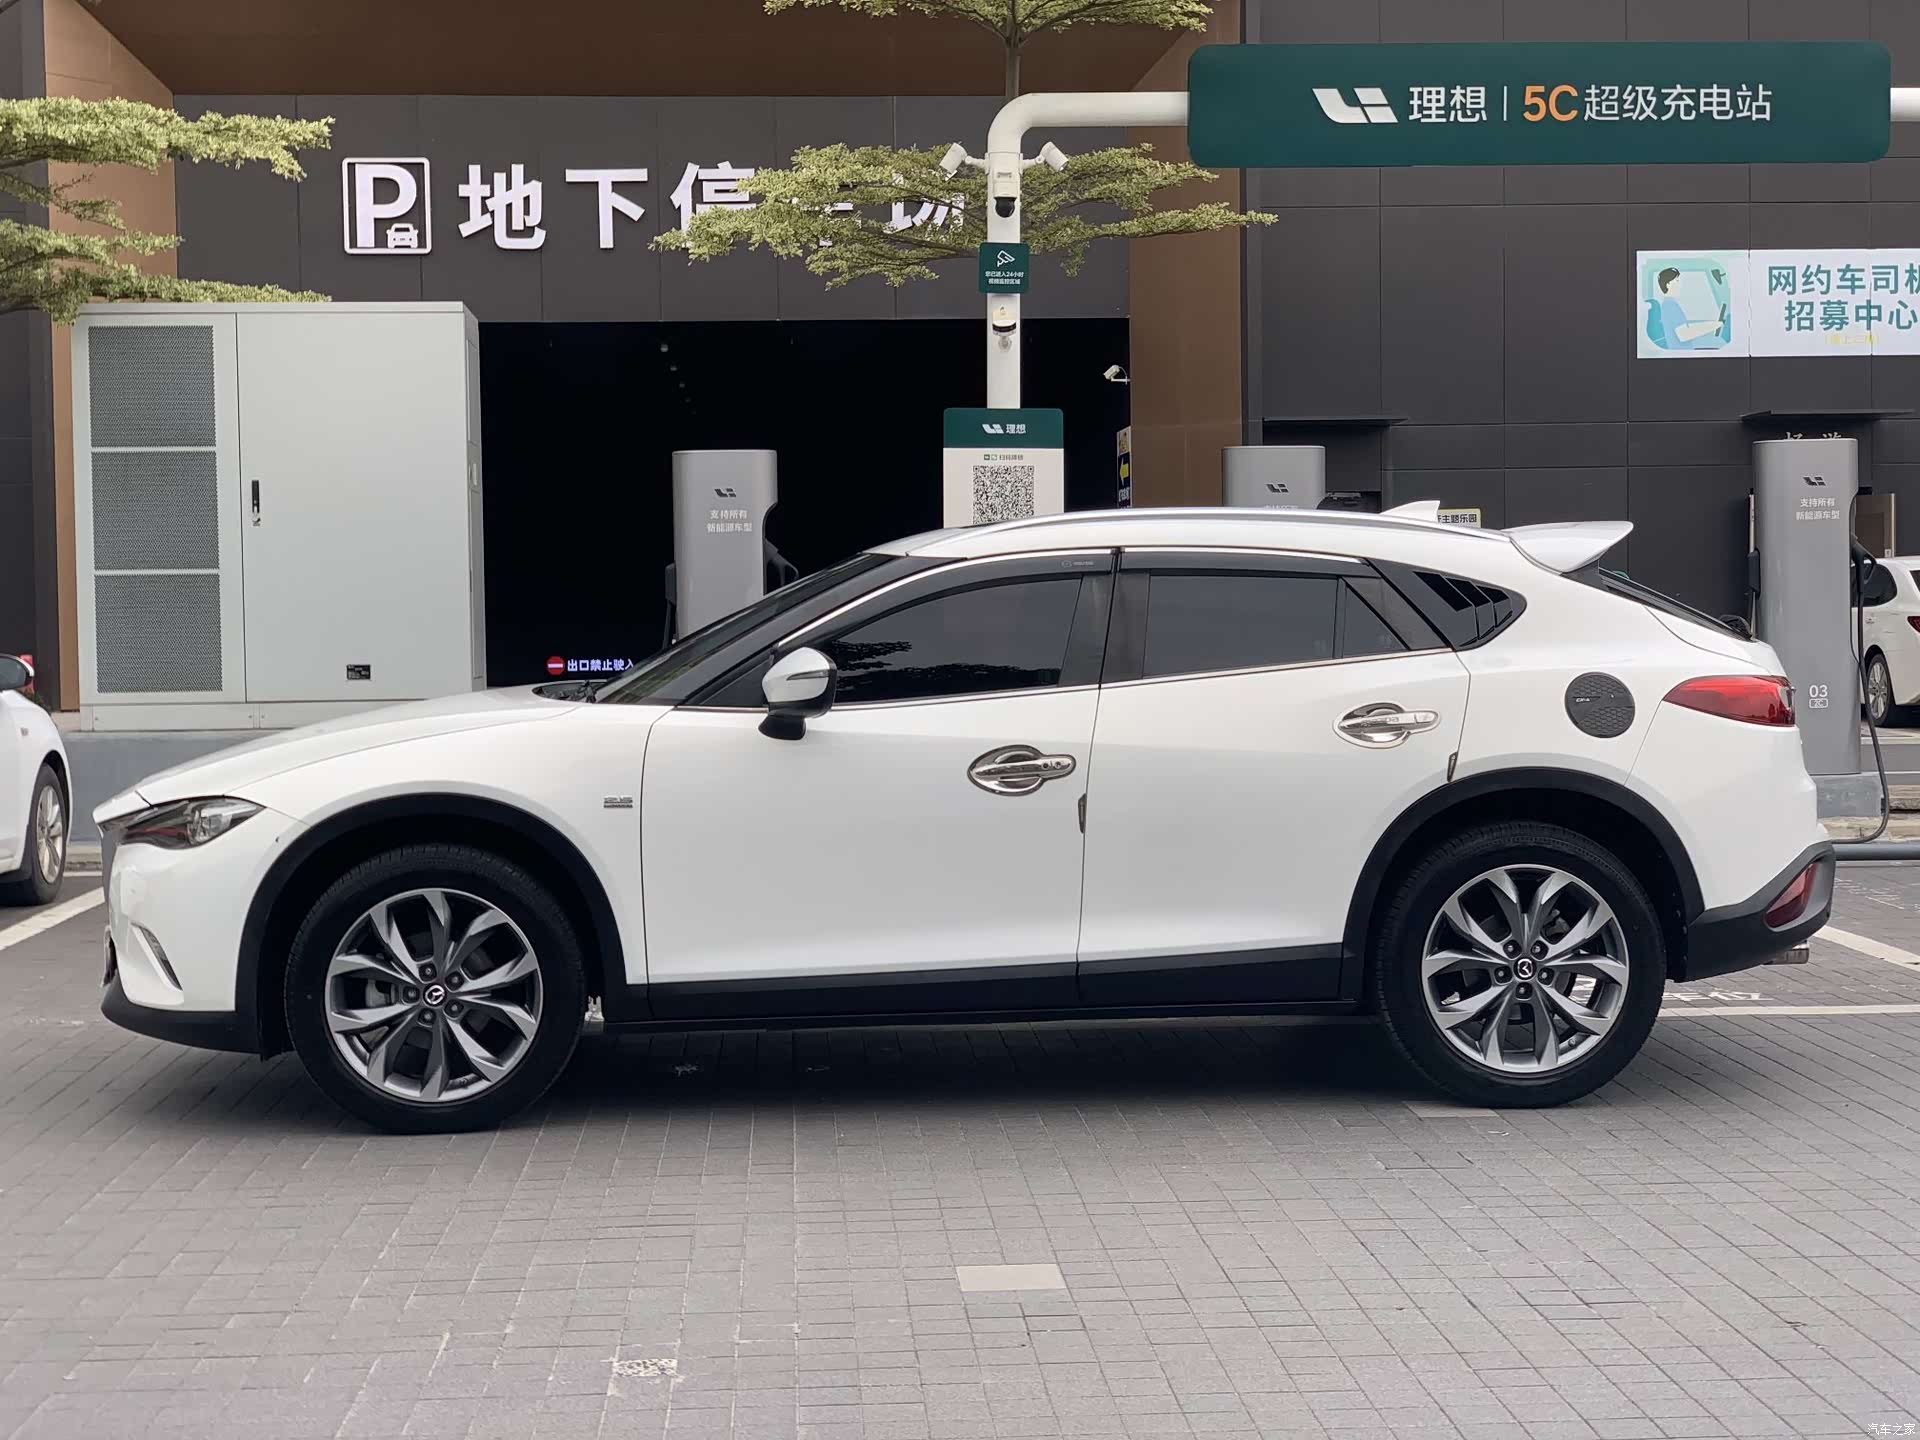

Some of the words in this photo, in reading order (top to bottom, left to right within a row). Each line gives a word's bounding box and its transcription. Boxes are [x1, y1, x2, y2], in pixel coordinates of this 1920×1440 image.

[1408, 86, 1488, 123] 理想
[457, 161, 966, 250] 地下停
[1784, 299, 1918, 332] 招募中心
[1005, 423, 1026, 434] 理想
[1800, 497, 1835, 508] 支持所有
[709, 509, 748, 520] 支持所有
[1796, 510, 1840, 520] 新能源车型
[567, 658, 633, 672] 出口禁止驶入
[1809, 684, 1828, 698] 03
